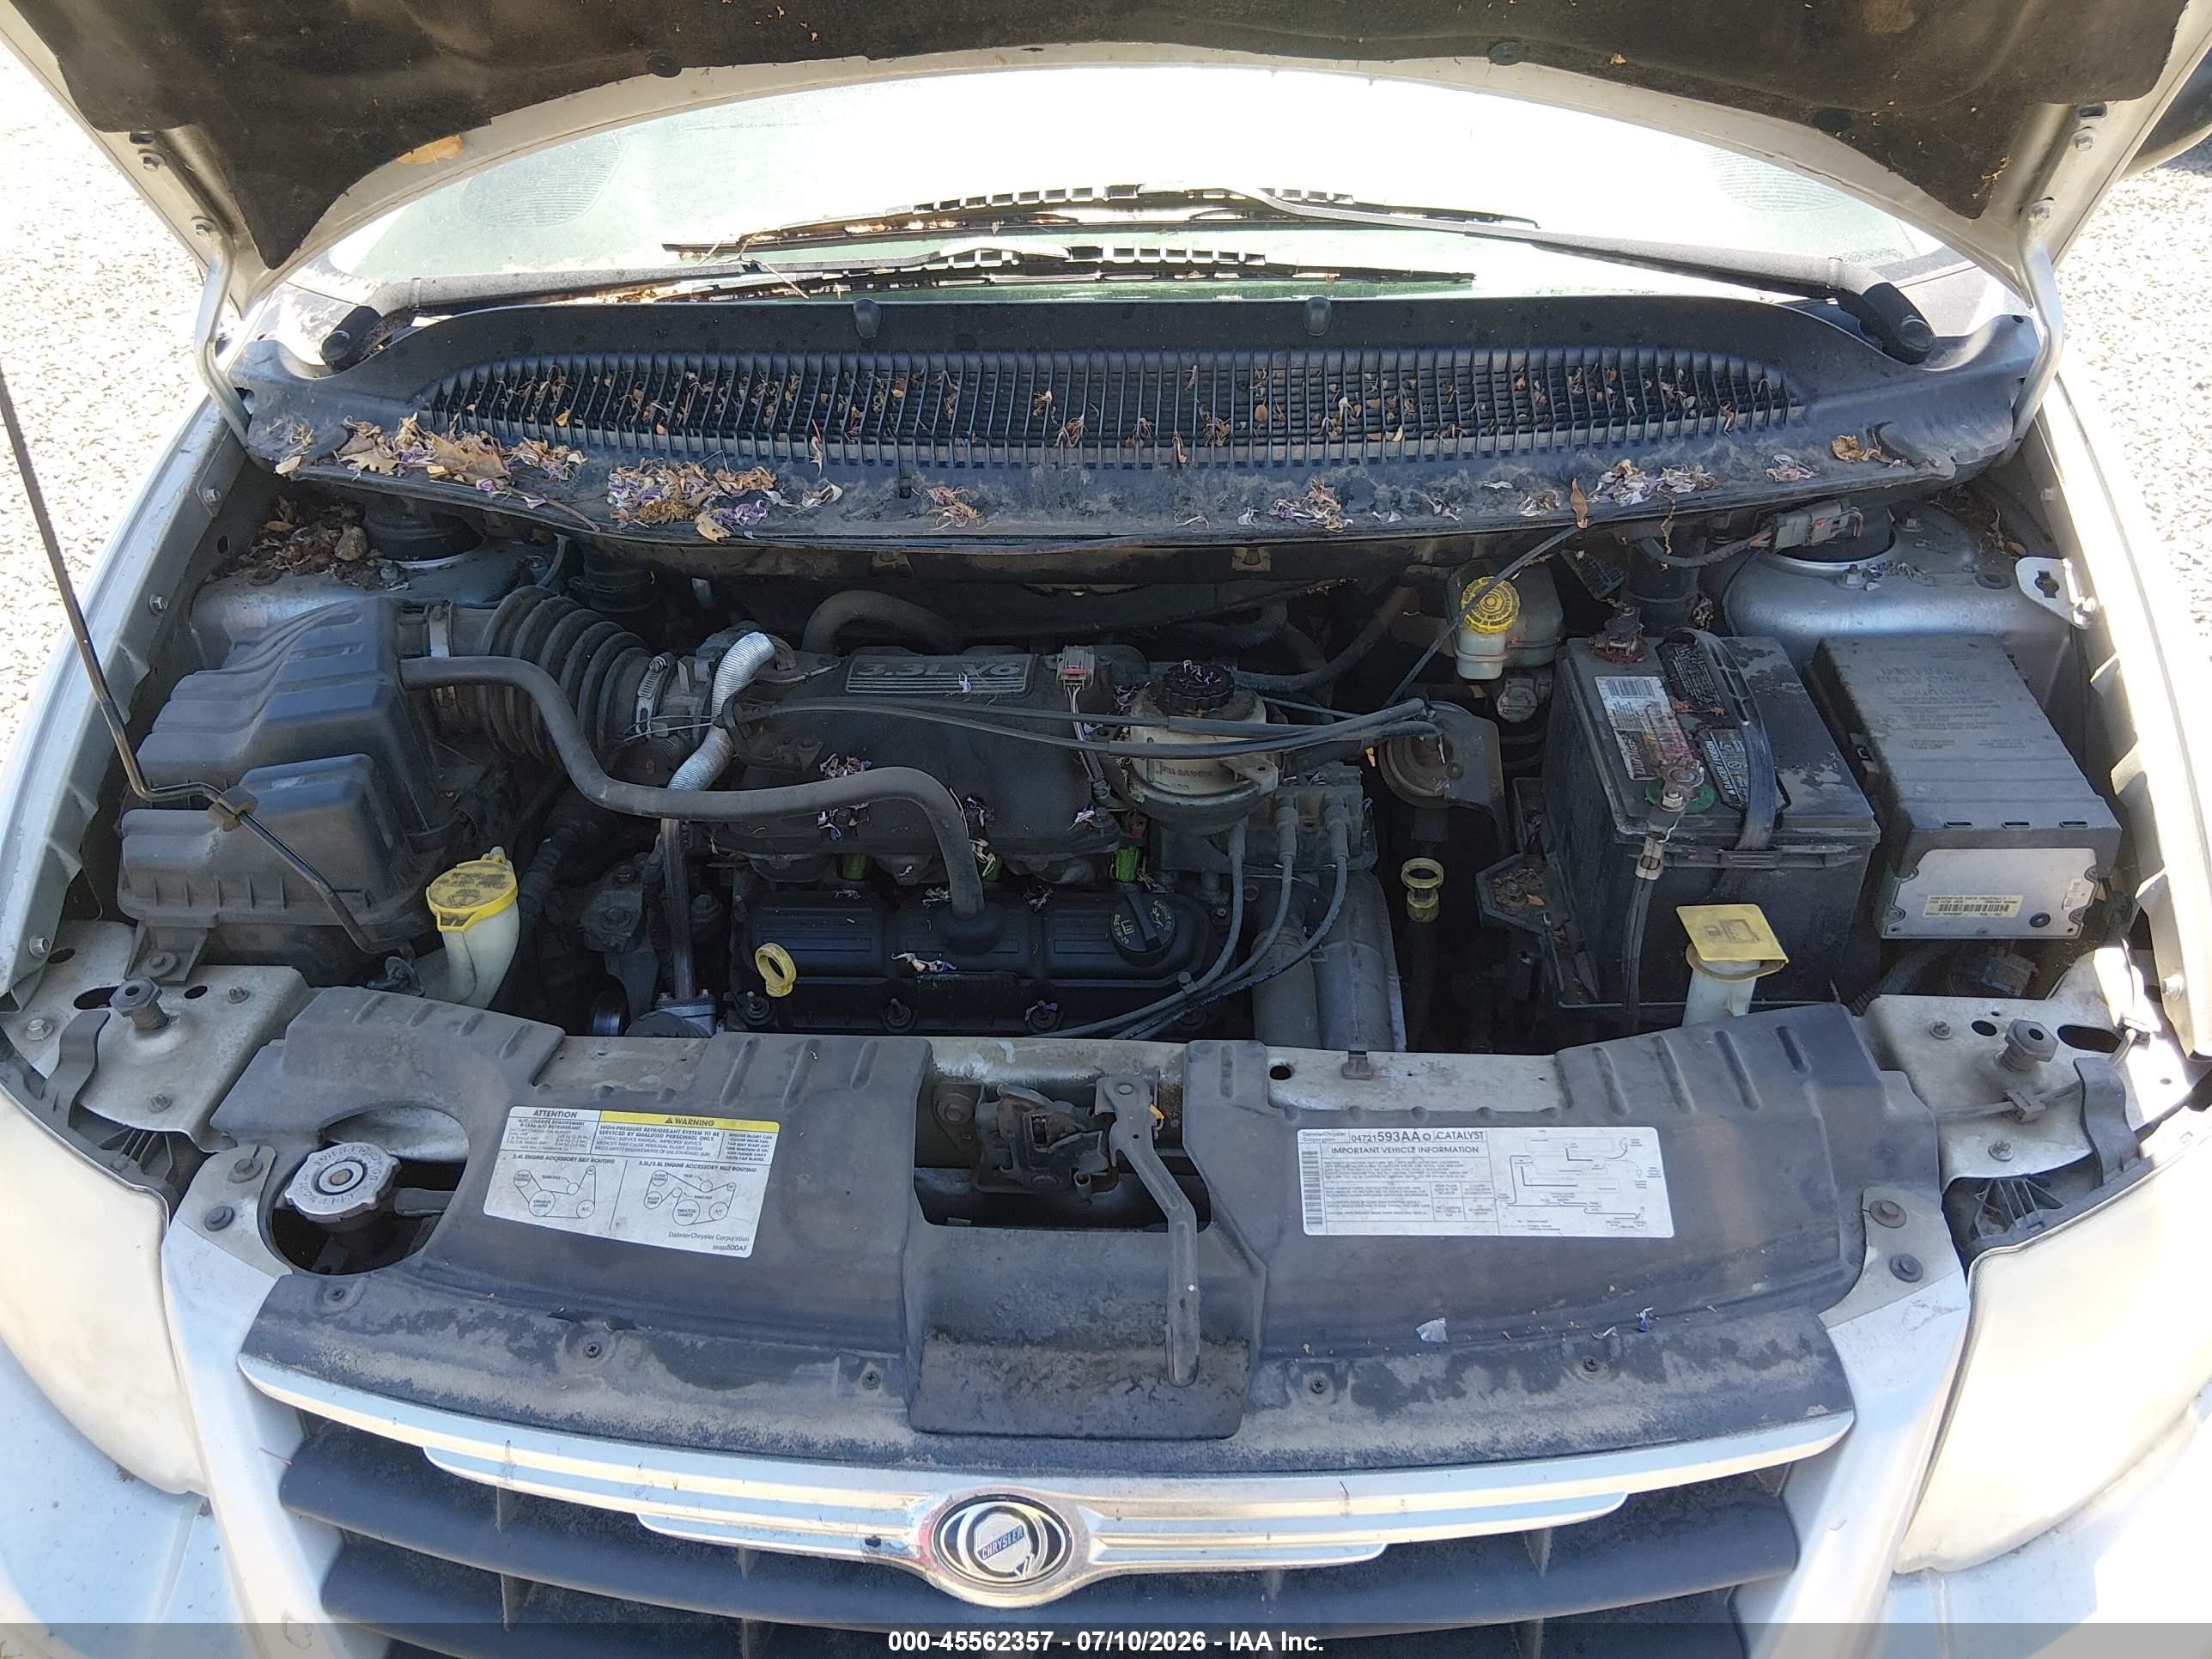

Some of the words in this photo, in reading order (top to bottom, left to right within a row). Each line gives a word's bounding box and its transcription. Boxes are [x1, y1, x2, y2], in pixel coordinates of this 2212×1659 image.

[857, 662, 954, 677] 3.3L
[962, 662, 1021, 677] V6
[1704, 740, 1722, 761] POISON
[1717, 765, 1734, 789] DANGER
[532, 1109, 578, 1119] ATTENTION
[674, 1117, 715, 1127] WARNING
[1436, 1131, 1485, 1140] CATALYST
[668, 1231, 715, 1240] DaimlerChrysler
[715, 1234, 750, 1243] Corporation
[981, 1524, 1025, 1559] CHRYSLER
